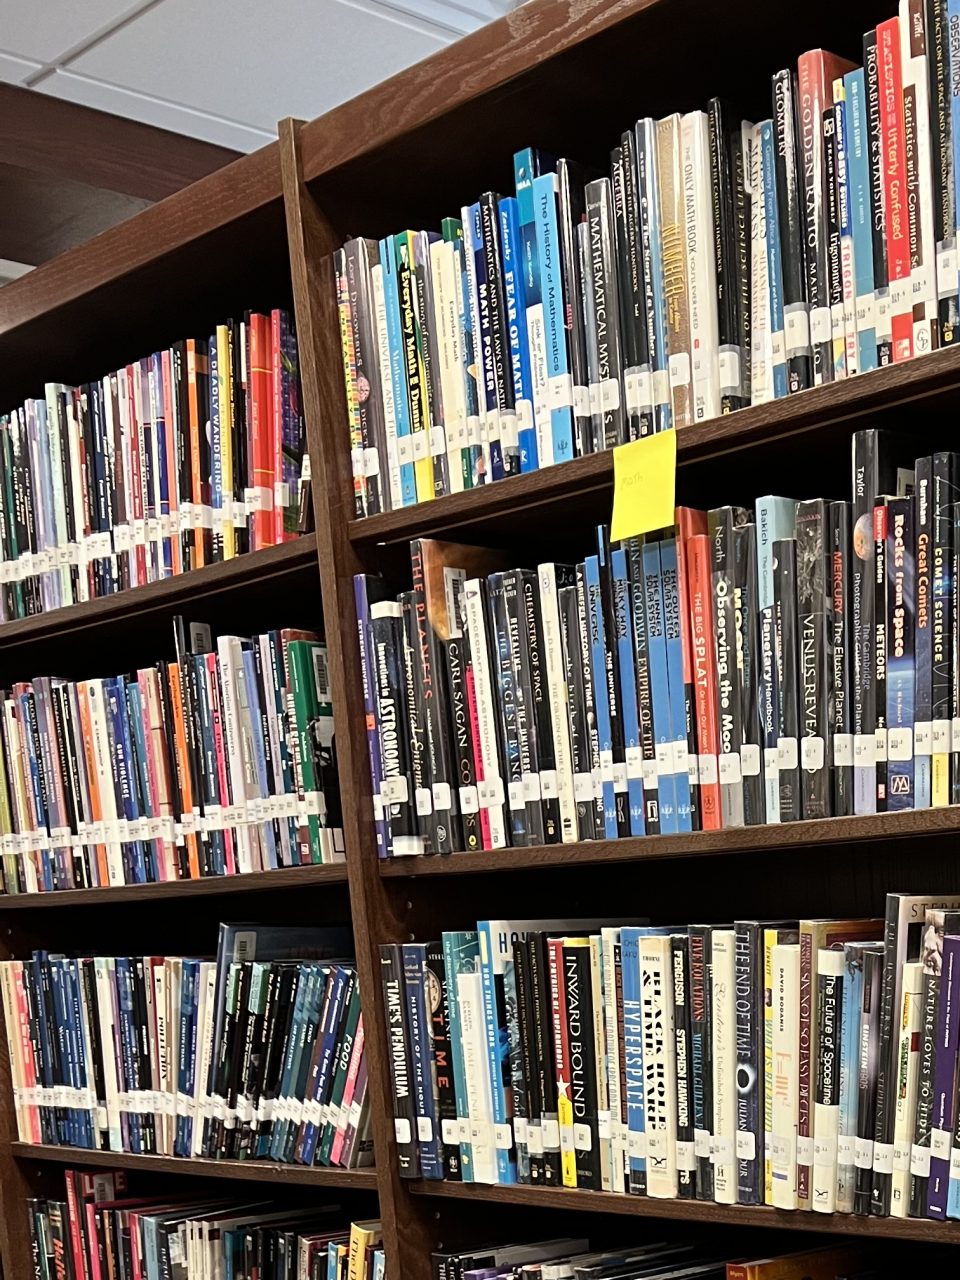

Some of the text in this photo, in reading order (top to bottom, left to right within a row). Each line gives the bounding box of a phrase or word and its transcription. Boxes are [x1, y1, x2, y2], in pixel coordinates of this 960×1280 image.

[802, 94, 815, 175] GOLDEN
[889, 180, 904, 240] Confused
[541, 220, 559, 372] History Mathematics
[590, 218, 606, 341] MATHEMATICAL
[479, 284, 494, 391] MATH POWER
[760, 509, 768, 546] Bakich
[856, 466, 864, 497] Taylor
[716, 582, 728, 675] Observing
[893, 514, 904, 658] Rocks Space
[918, 533, 929, 628] Great Comets
[696, 636, 706, 686] SPLAT
[833, 551, 844, 728] MERCURY Elusive Planet
[380, 699, 399, 780] ASTRONOMY
[449, 644, 467, 747] CARL SAGAN
[387, 980, 409, 1097] TIME'S PENDULUM
[566, 956, 586, 1117] INWARD BOUND
[623, 1000, 643, 1110] HYPERSPACE
